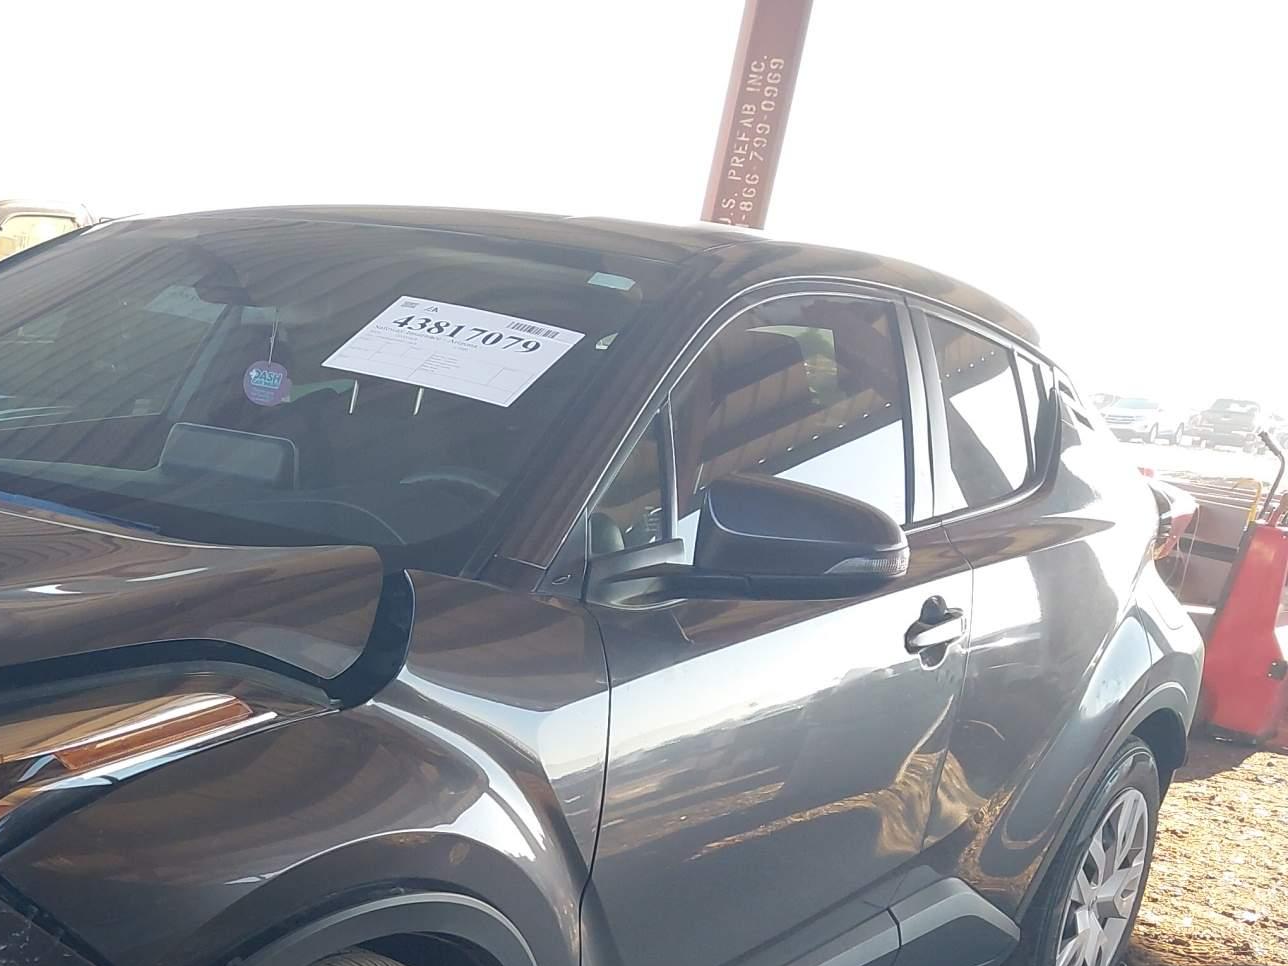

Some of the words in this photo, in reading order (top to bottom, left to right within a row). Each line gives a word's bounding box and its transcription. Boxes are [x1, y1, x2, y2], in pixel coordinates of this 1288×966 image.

[728, 103, 756, 180] PREFAB
[747, 55, 768, 92] INC.
[392, 314, 543, 353] 43817079
